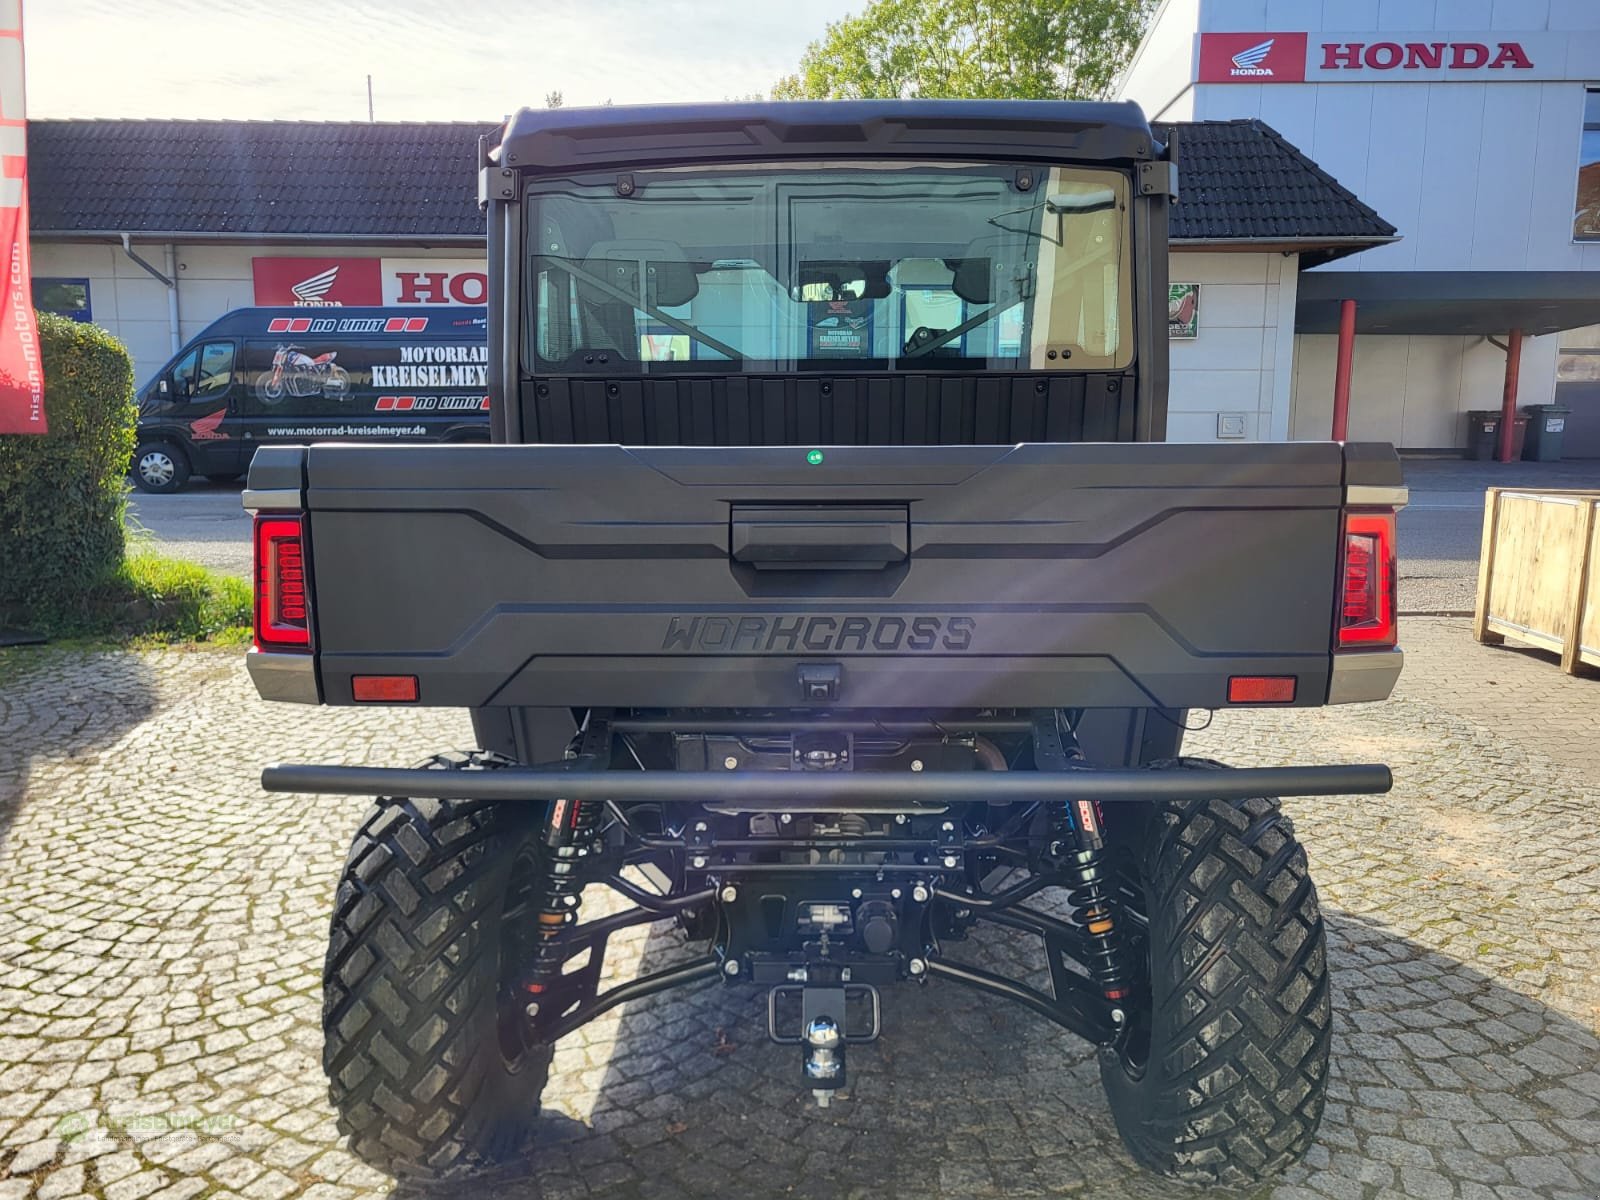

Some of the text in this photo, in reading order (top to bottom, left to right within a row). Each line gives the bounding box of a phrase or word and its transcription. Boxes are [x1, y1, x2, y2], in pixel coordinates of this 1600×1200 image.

[1320, 42, 1534, 69] HONDA
[11, 242, 41, 421] hisun-motors.com
[371, 365, 488, 387] KREISELMEY
[191, 432, 231, 440] HONDA
[267, 425, 427, 438] www.motorrad-kreiselmeyer.de
[662, 616, 977, 651] WORKCROSS
